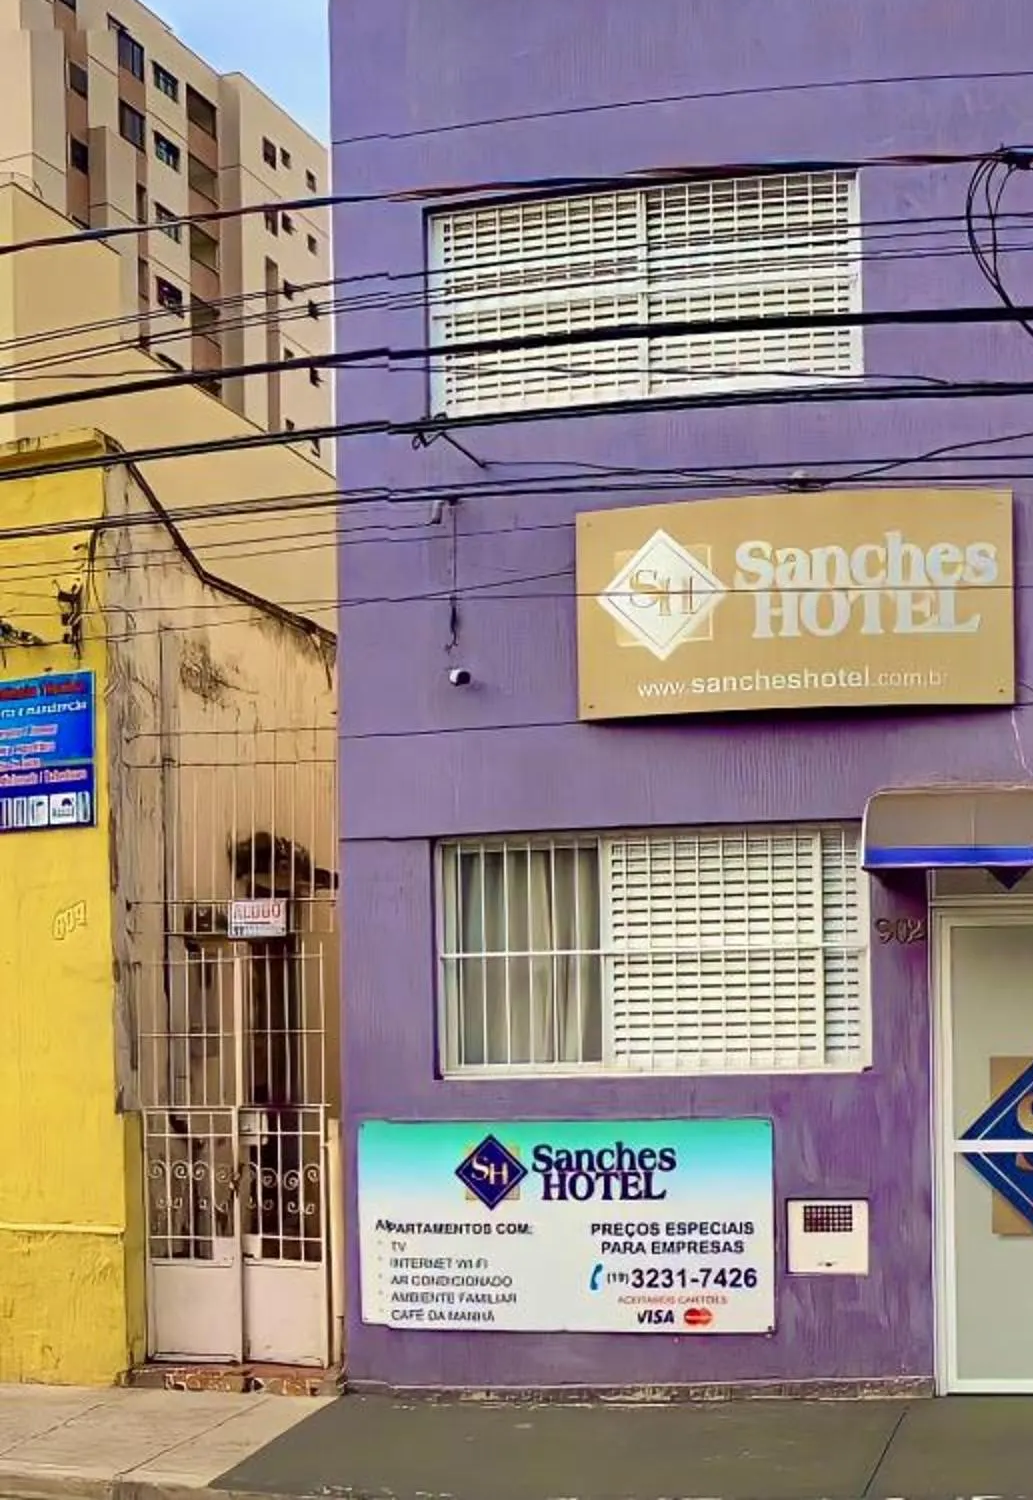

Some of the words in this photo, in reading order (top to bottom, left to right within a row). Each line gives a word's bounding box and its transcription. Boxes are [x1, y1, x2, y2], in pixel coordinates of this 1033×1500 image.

[733, 528, 999, 590] Sanches
[751, 585, 982, 639] HOTEL
[875, 918, 925, 945] 902
[531, 1140, 678, 1173] Sanches
[541, 1170, 668, 1201] HOTEL
[590, 1223, 661, 1239] PREÇOS
[665, 1221, 755, 1236] ESPECIAIS
[390, 1241, 407, 1252] TV
[601, 1241, 647, 1255] PARA
[651, 1240, 745, 1255] EMPRESAS
[389, 1258, 453, 1270] INTERNET
[390, 1275, 409, 1286] AR
[410, 1275, 514, 1287] CONDICIONADO
[631, 1267, 758, 1289] 3231-7426
[390, 1291, 455, 1304] AMBIENTE
[458, 1292, 518, 1305] FAMILIAR
[390, 1307, 425, 1322] CAFÉ
[427, 1310, 446, 1321] DA
[636, 1309, 676, 1324] VISA
